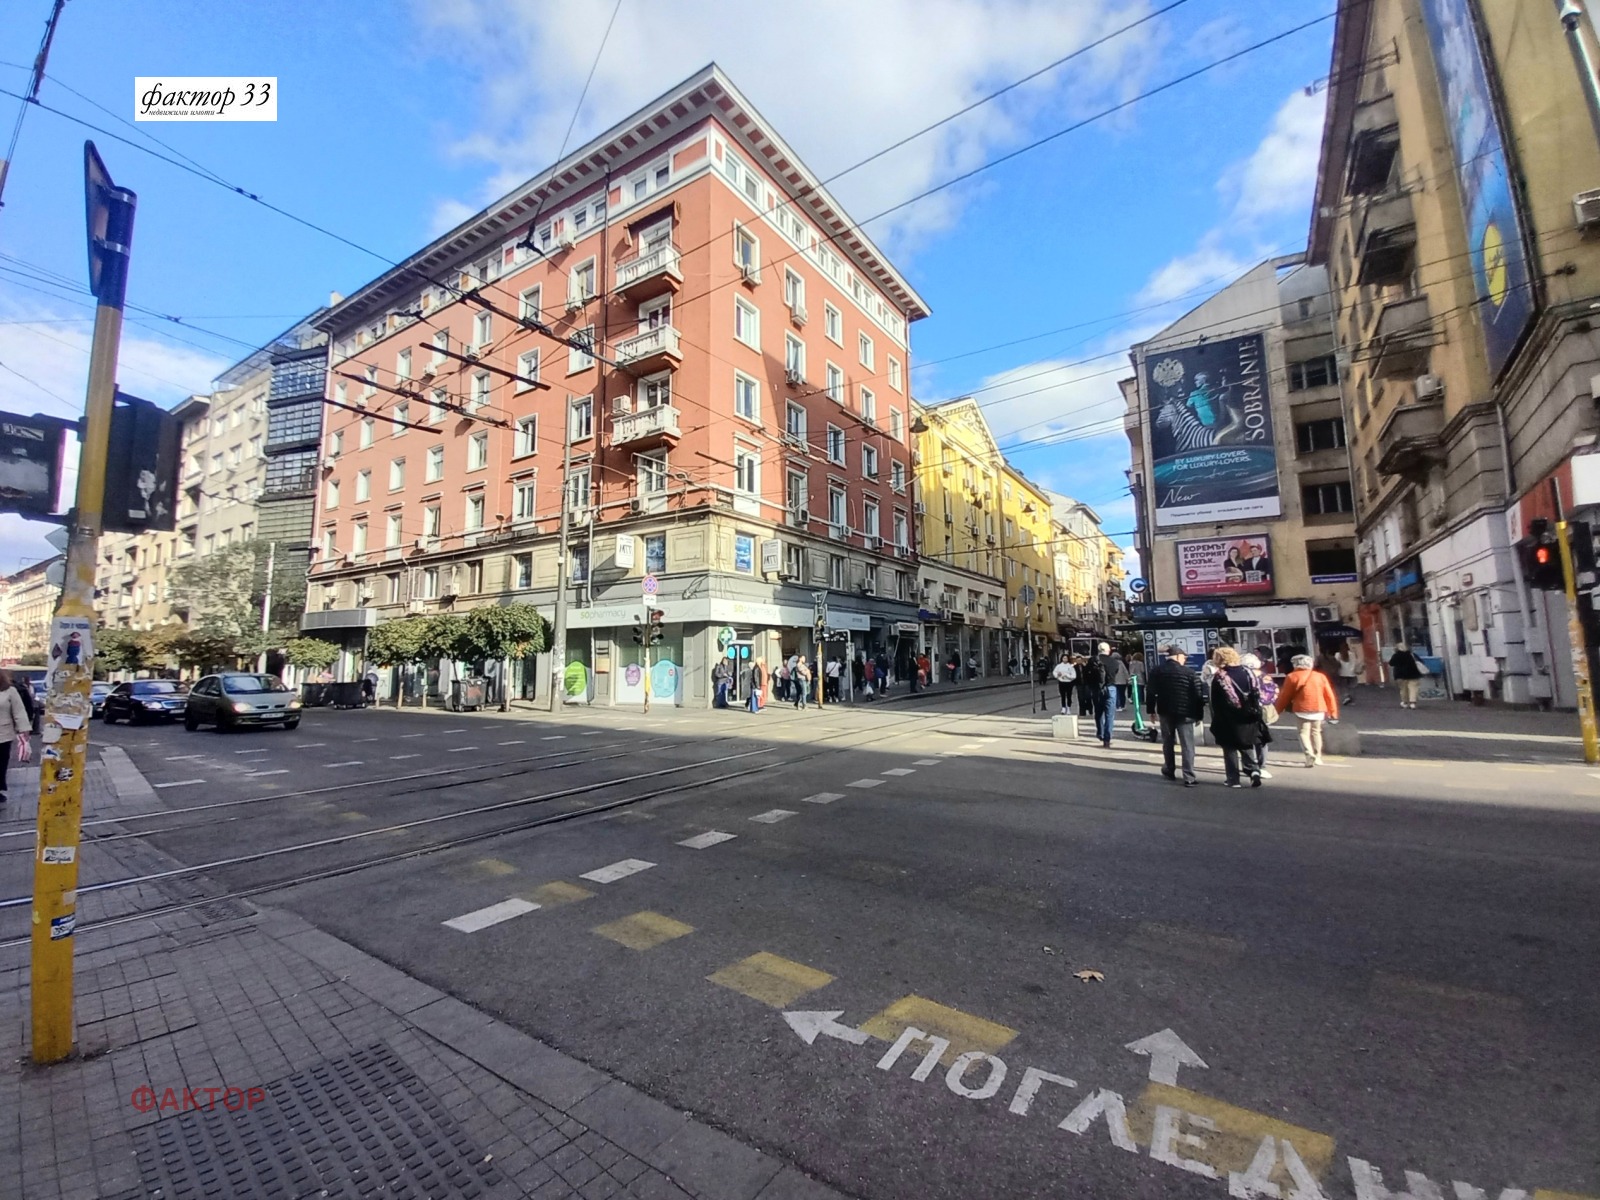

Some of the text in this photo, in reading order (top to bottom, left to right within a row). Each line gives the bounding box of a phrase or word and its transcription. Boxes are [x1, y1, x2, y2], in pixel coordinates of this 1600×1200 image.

[1238, 339, 1266, 442] SOBRANIE
[1172, 462, 1189, 472] FOR
[1160, 485, 1201, 508] New
[1183, 543, 1227, 553] КОРЕМЪТ
[1190, 550, 1227, 559] ВТОРИЯТ
